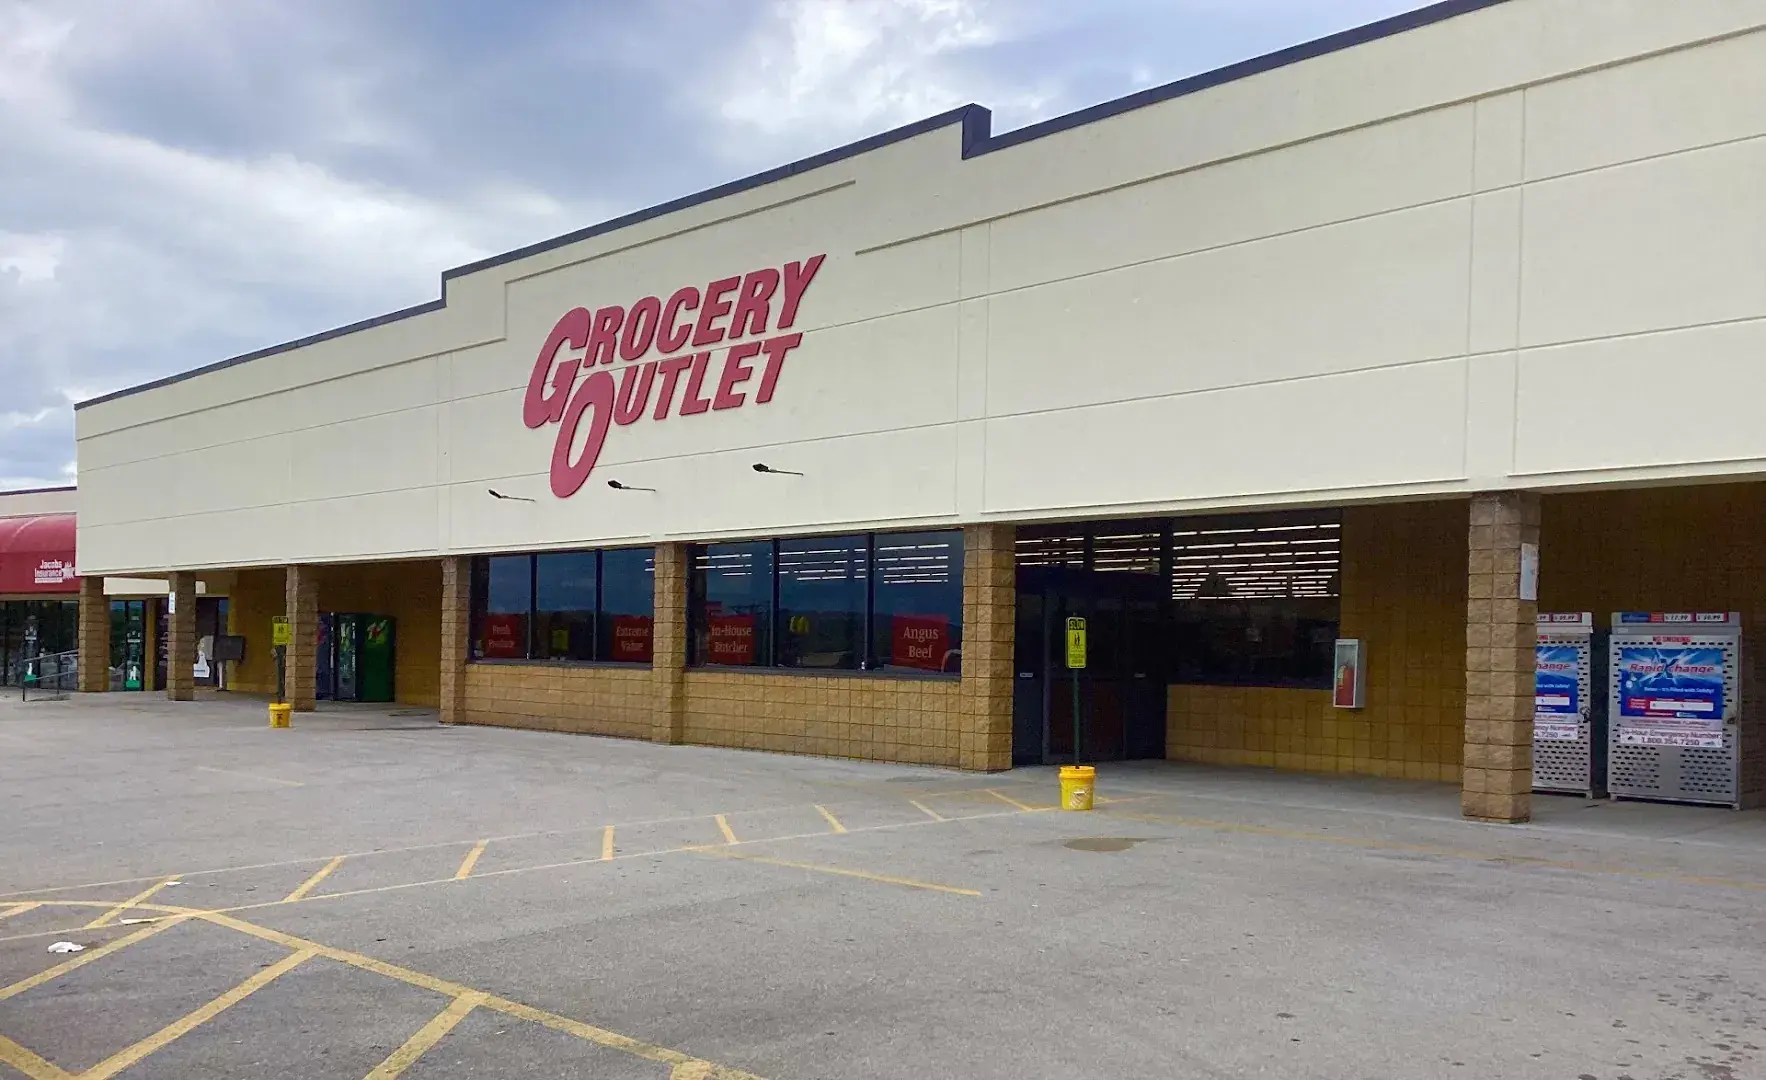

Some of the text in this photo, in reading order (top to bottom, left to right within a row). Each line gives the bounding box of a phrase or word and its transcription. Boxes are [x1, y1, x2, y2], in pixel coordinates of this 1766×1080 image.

[523, 253, 826, 429] GROCERY
[550, 333, 803, 498] OUTLET
[39, 559, 62, 569] Jacobs
[711, 624, 752, 636] In-House
[903, 626, 940, 643] Angus
[714, 640, 748, 653] Butcher
[908, 644, 934, 658] Beef
[1630, 663, 1664, 673] Rapid
